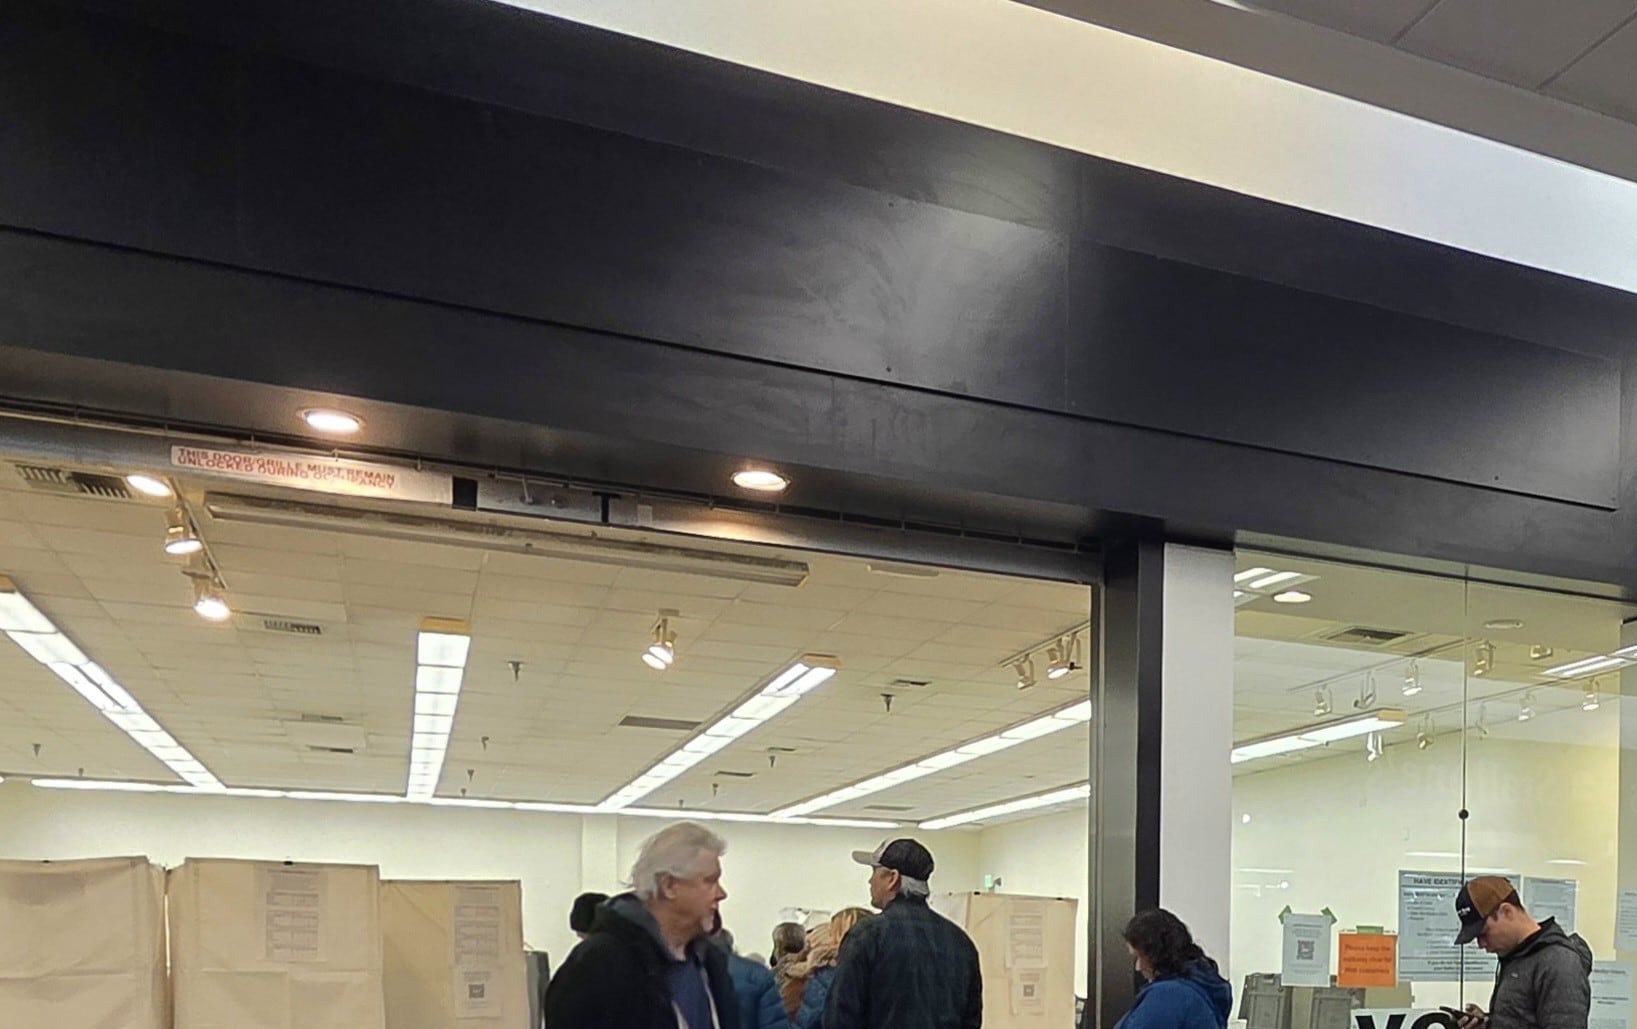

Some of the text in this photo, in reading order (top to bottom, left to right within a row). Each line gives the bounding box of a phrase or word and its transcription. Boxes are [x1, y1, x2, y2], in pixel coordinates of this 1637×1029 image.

[177, 456, 254, 473] UNLOCKED
[257, 464, 309, 480] DURING
[178, 447, 209, 460] THIS
[306, 463, 342, 475] MUST
[347, 468, 396, 481] REMAIN
